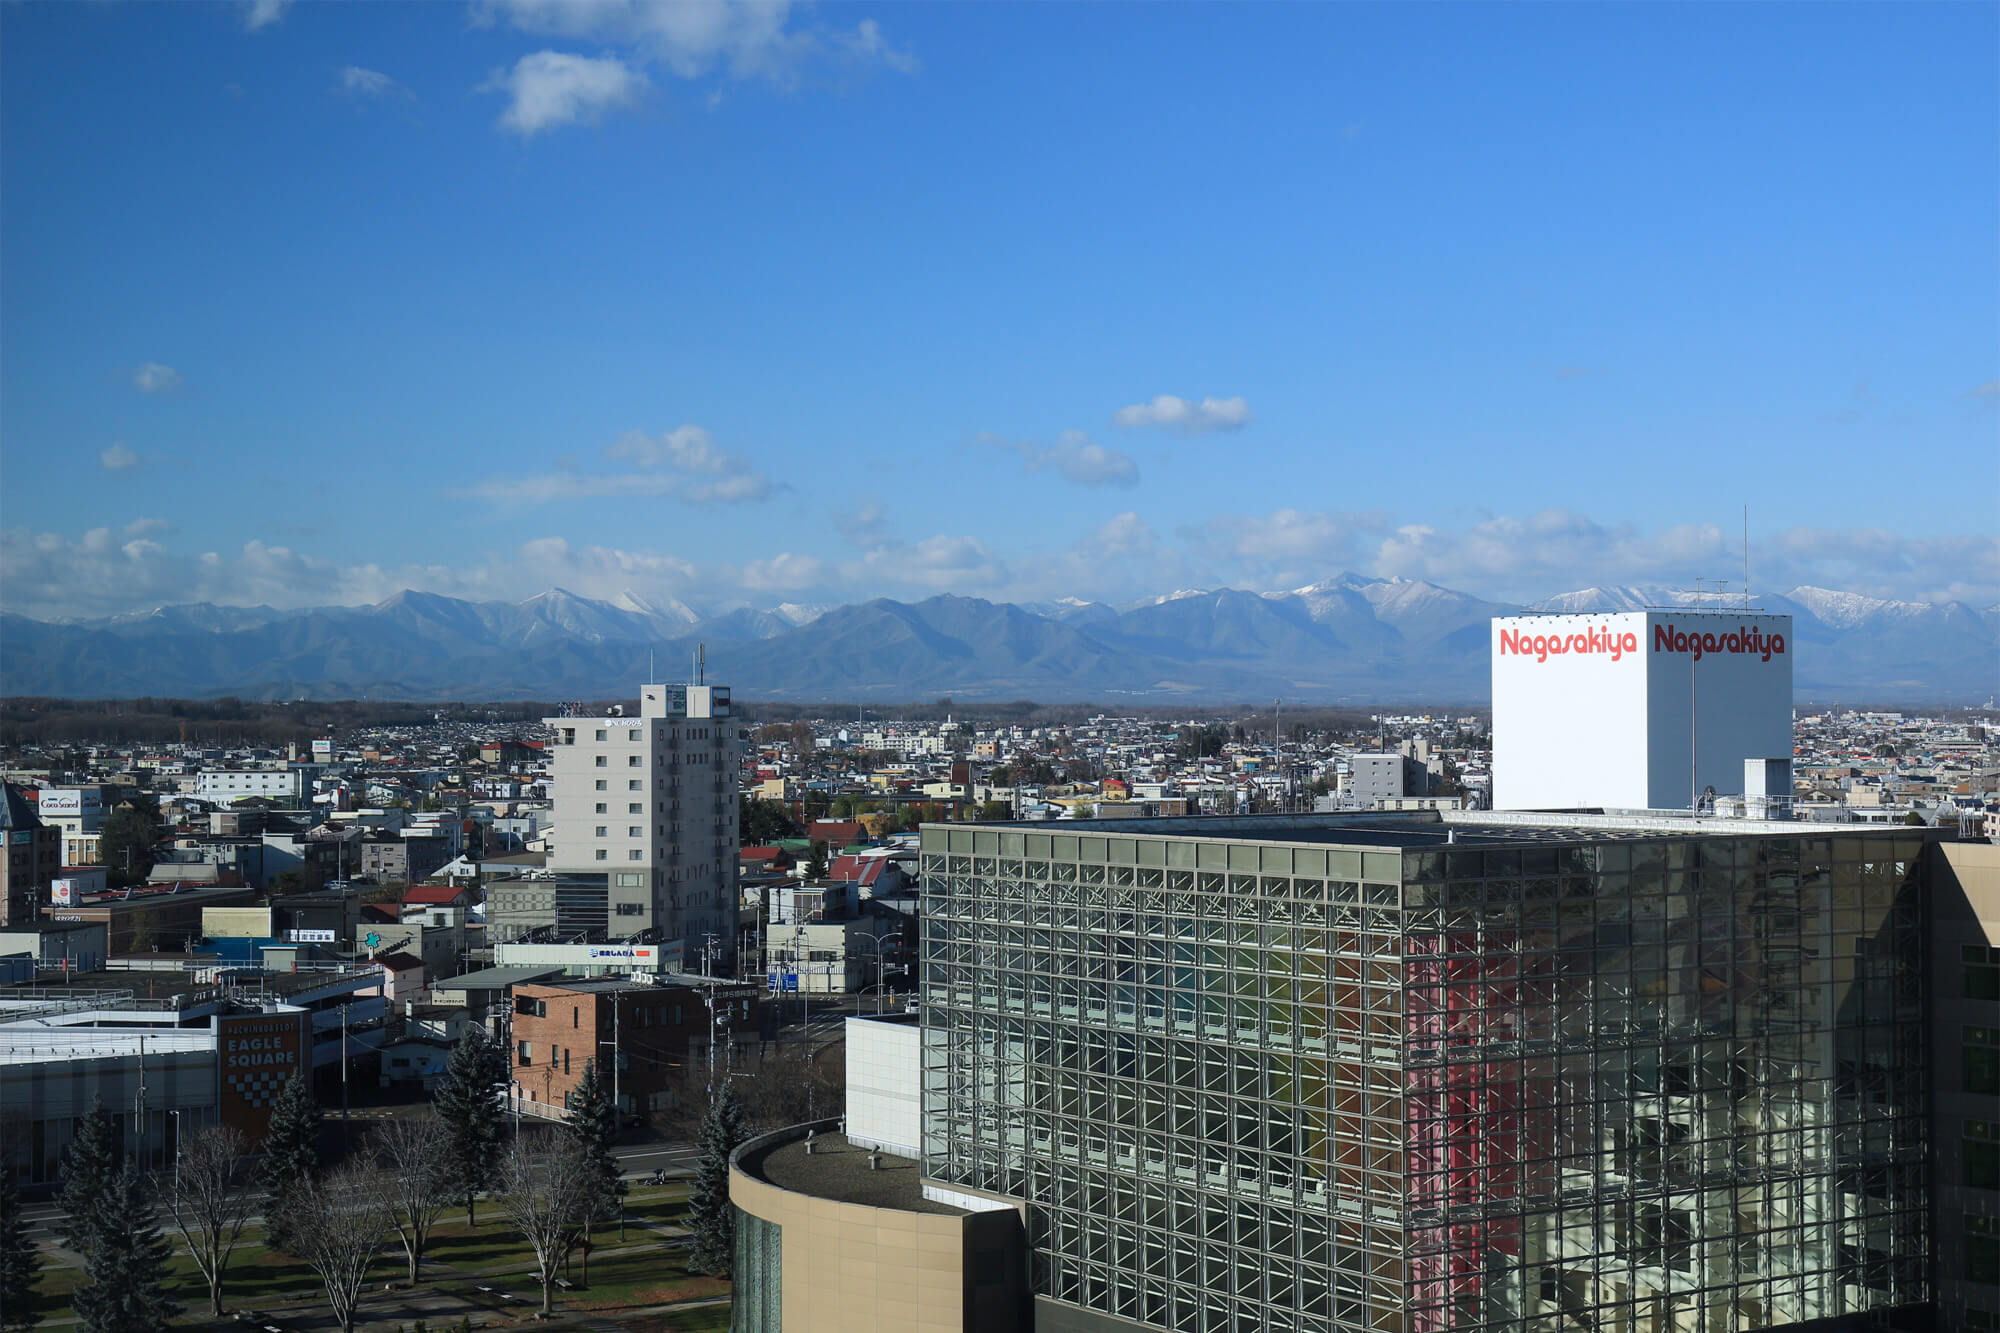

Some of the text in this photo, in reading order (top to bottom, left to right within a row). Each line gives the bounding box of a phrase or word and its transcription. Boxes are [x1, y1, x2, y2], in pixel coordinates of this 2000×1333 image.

[1500, 626, 1637, 663] Nagasakiya
[1655, 624, 1785, 662] Nagasakiya
[228, 1037, 281, 1052] EAGLE
[227, 1051, 295, 1067] SQUARE
